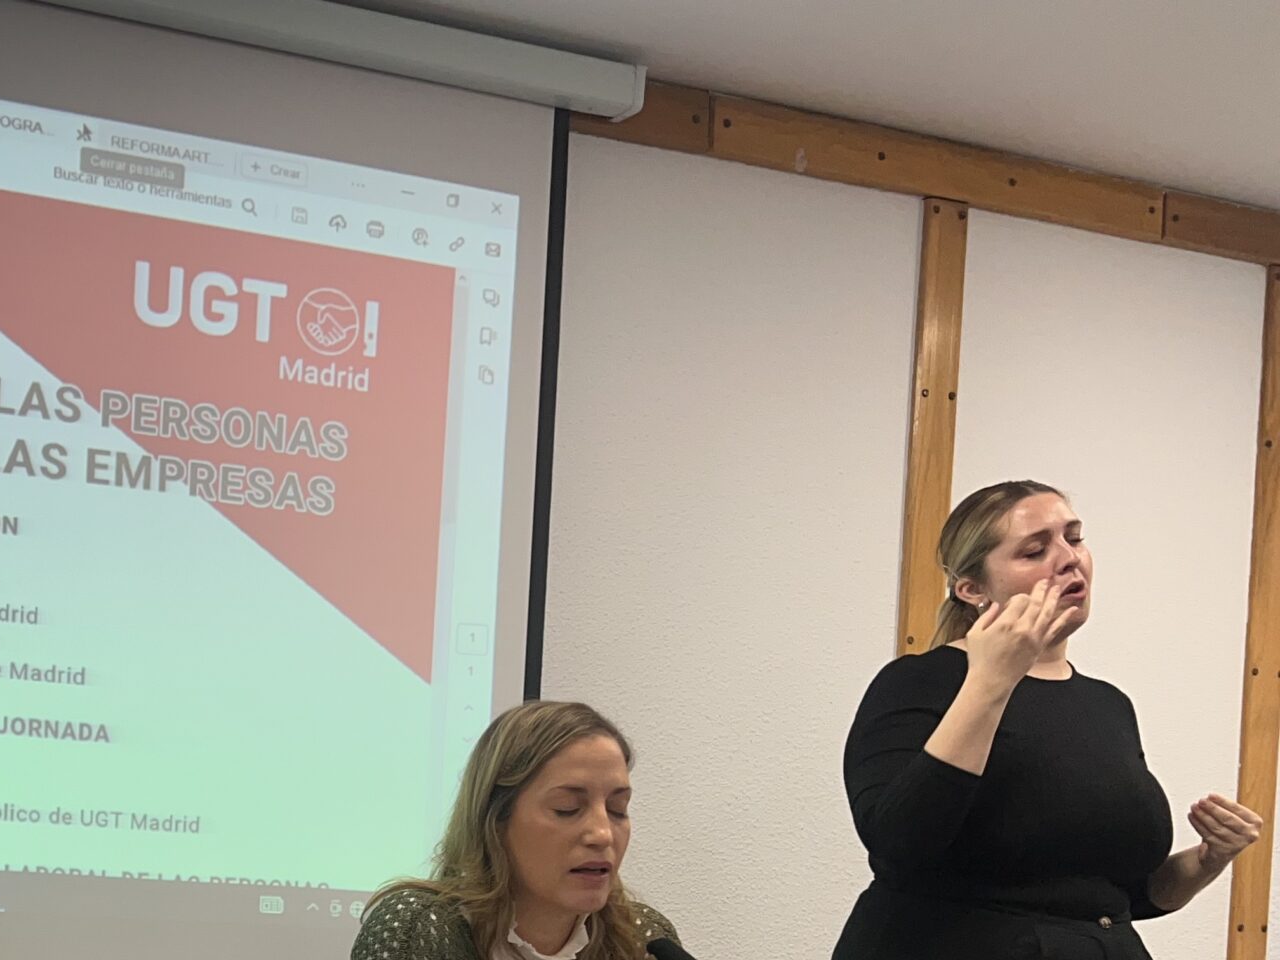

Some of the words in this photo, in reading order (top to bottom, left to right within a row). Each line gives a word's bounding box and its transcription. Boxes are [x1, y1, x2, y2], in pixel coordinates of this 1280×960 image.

[90, 154, 125, 172] Cerrar
[128, 162, 174, 183] pestaña
[270, 164, 300, 180] Crear
[53, 166, 99, 187] Buscar
[137, 182, 146, 194] o
[149, 184, 232, 210] herramientas
[133, 260, 288, 343] UGT
[279, 355, 370, 392] Madrid
[100, 388, 348, 461] PERSONAS
[86, 447, 335, 516] EMPRESAS
[9, 661, 86, 686] Madrid
[48, 807, 74, 827] de
[80, 810, 124, 830] UGT
[130, 811, 201, 835] Madrid
